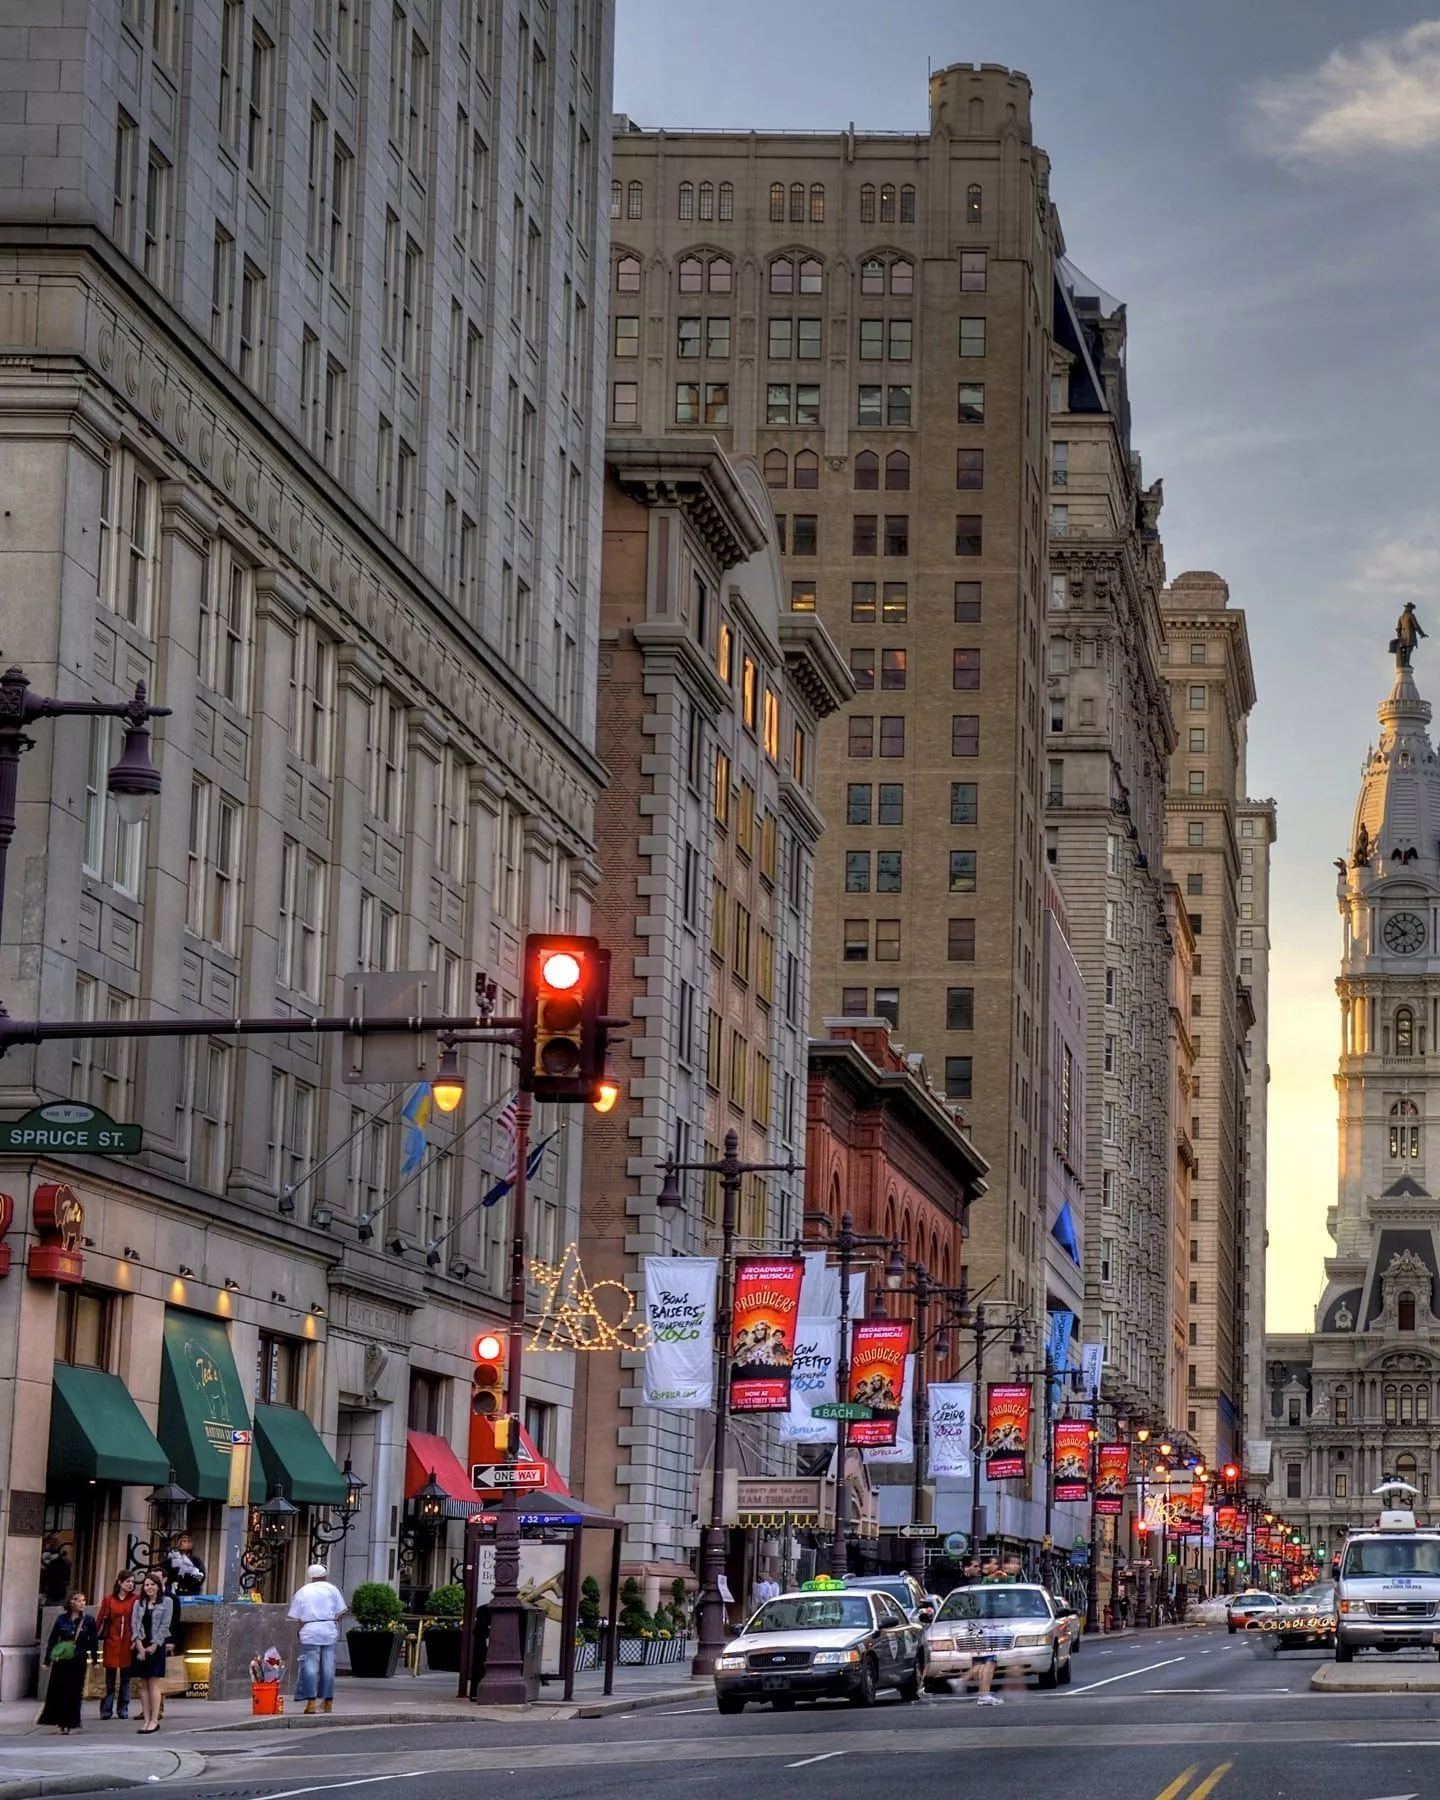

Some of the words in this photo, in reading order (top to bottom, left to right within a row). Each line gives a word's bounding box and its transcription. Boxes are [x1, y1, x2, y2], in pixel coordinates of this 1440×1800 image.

[10, 1130, 88, 1145] SPRUCE
[98, 1132, 124, 1146] ST.
[735, 1291, 796, 1313] PRODUCERS
[654, 1328, 700, 1343] XOXO
[792, 1356, 832, 1369] FFETTO
[823, 1408, 853, 1418] BACH
[495, 1471, 515, 1481] ONE
[519, 1471, 537, 1480] WAY
